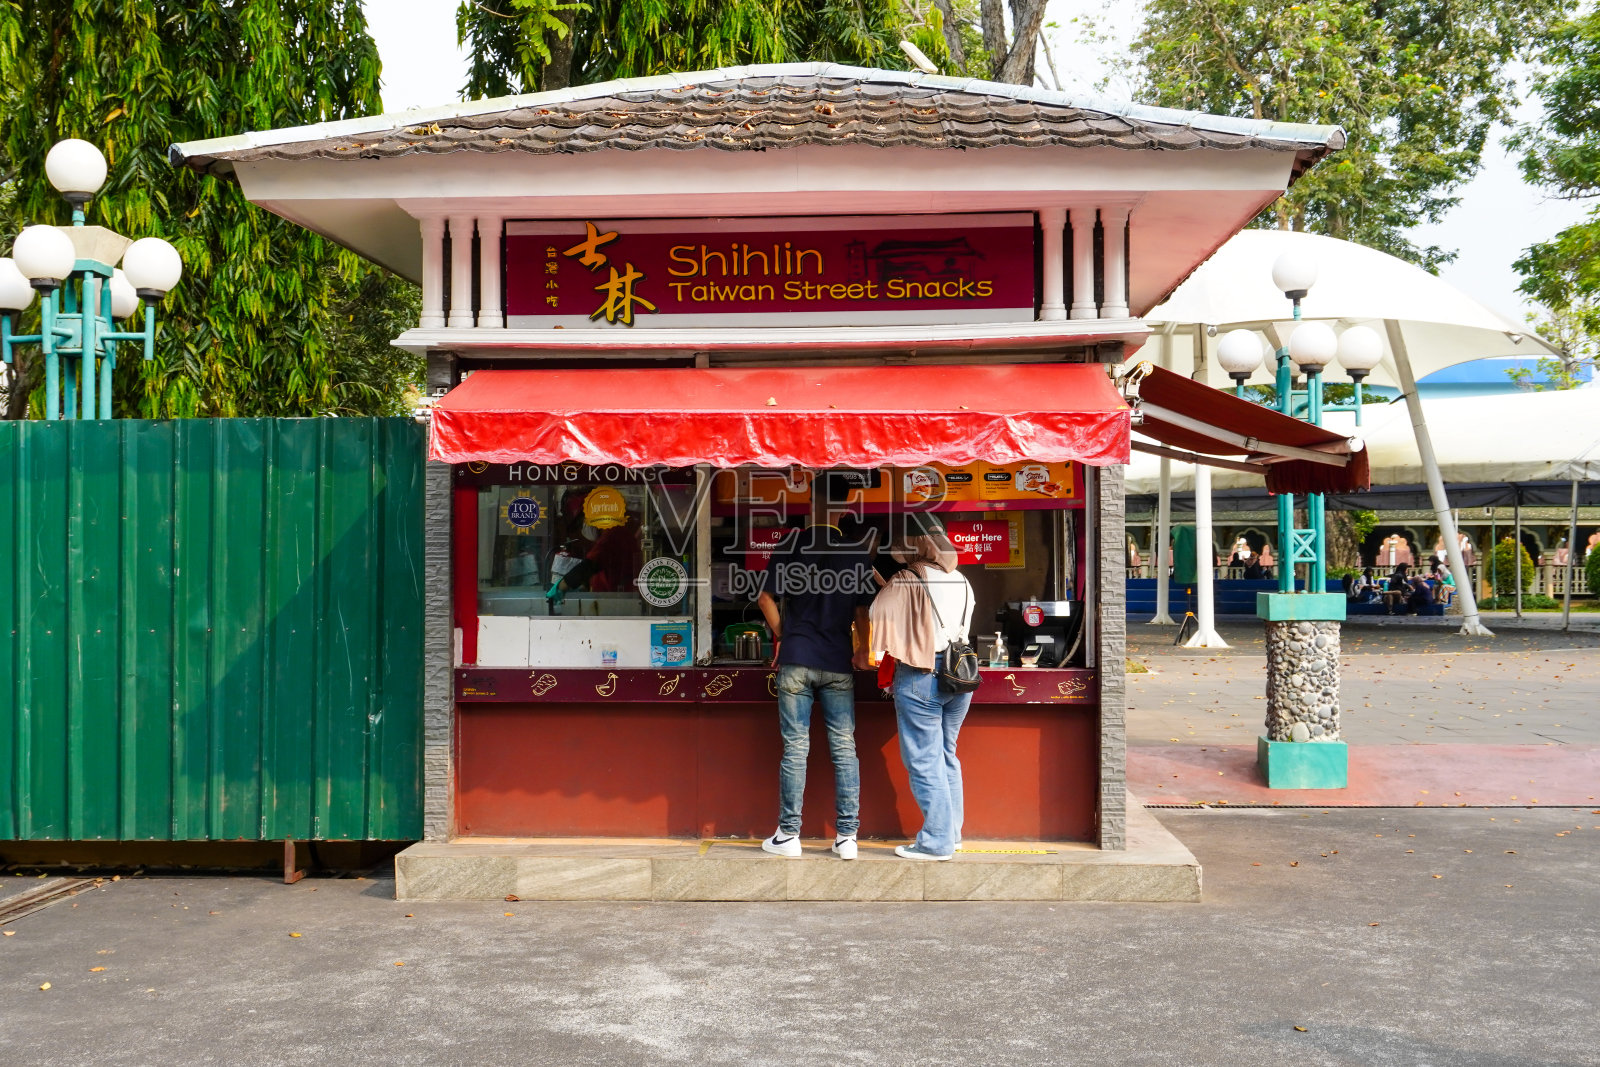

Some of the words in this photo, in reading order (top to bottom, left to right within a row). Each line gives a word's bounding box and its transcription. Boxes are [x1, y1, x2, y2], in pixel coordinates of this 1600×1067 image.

[667, 241, 823, 277] Shihlin
[562, 221, 657, 326] 士林
[668, 281, 775, 302] Taiwan
[783, 280, 879, 300] Street
[886, 277, 994, 299] Snacks
[508, 464, 579, 482] HONG
[588, 464, 657, 482] KONG
[512, 503, 536, 513] TOP
[972, 523, 983, 532] (1)
[771, 531, 782, 540] (2)
[954, 534, 980, 543] Order
[981, 533, 1003, 542] Here
[750, 541, 777, 550] Collec
[645, 592, 683, 605] INDONESIA
